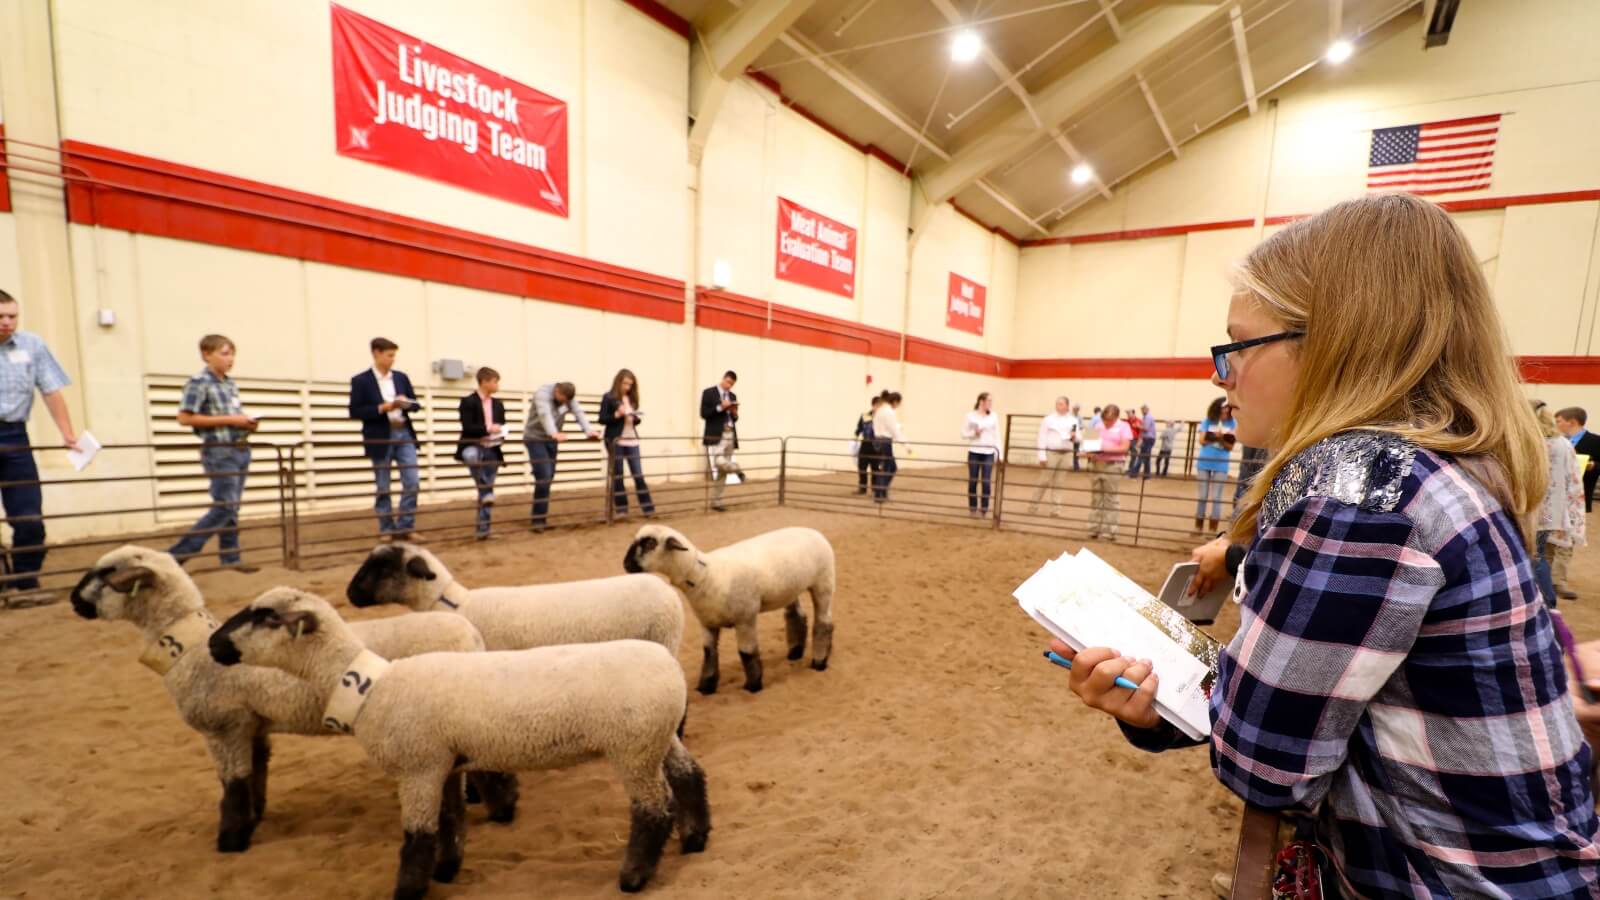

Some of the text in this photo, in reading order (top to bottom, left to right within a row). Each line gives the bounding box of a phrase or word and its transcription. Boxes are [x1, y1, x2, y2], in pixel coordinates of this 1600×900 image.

[398, 44, 518, 124] Livestock
[374, 80, 546, 171] Judging Team
[791, 210, 848, 250] Meat Animal
[781, 232, 853, 275] Evaluation Team
[159, 635, 183, 658] 3
[342, 671, 372, 696] 2
